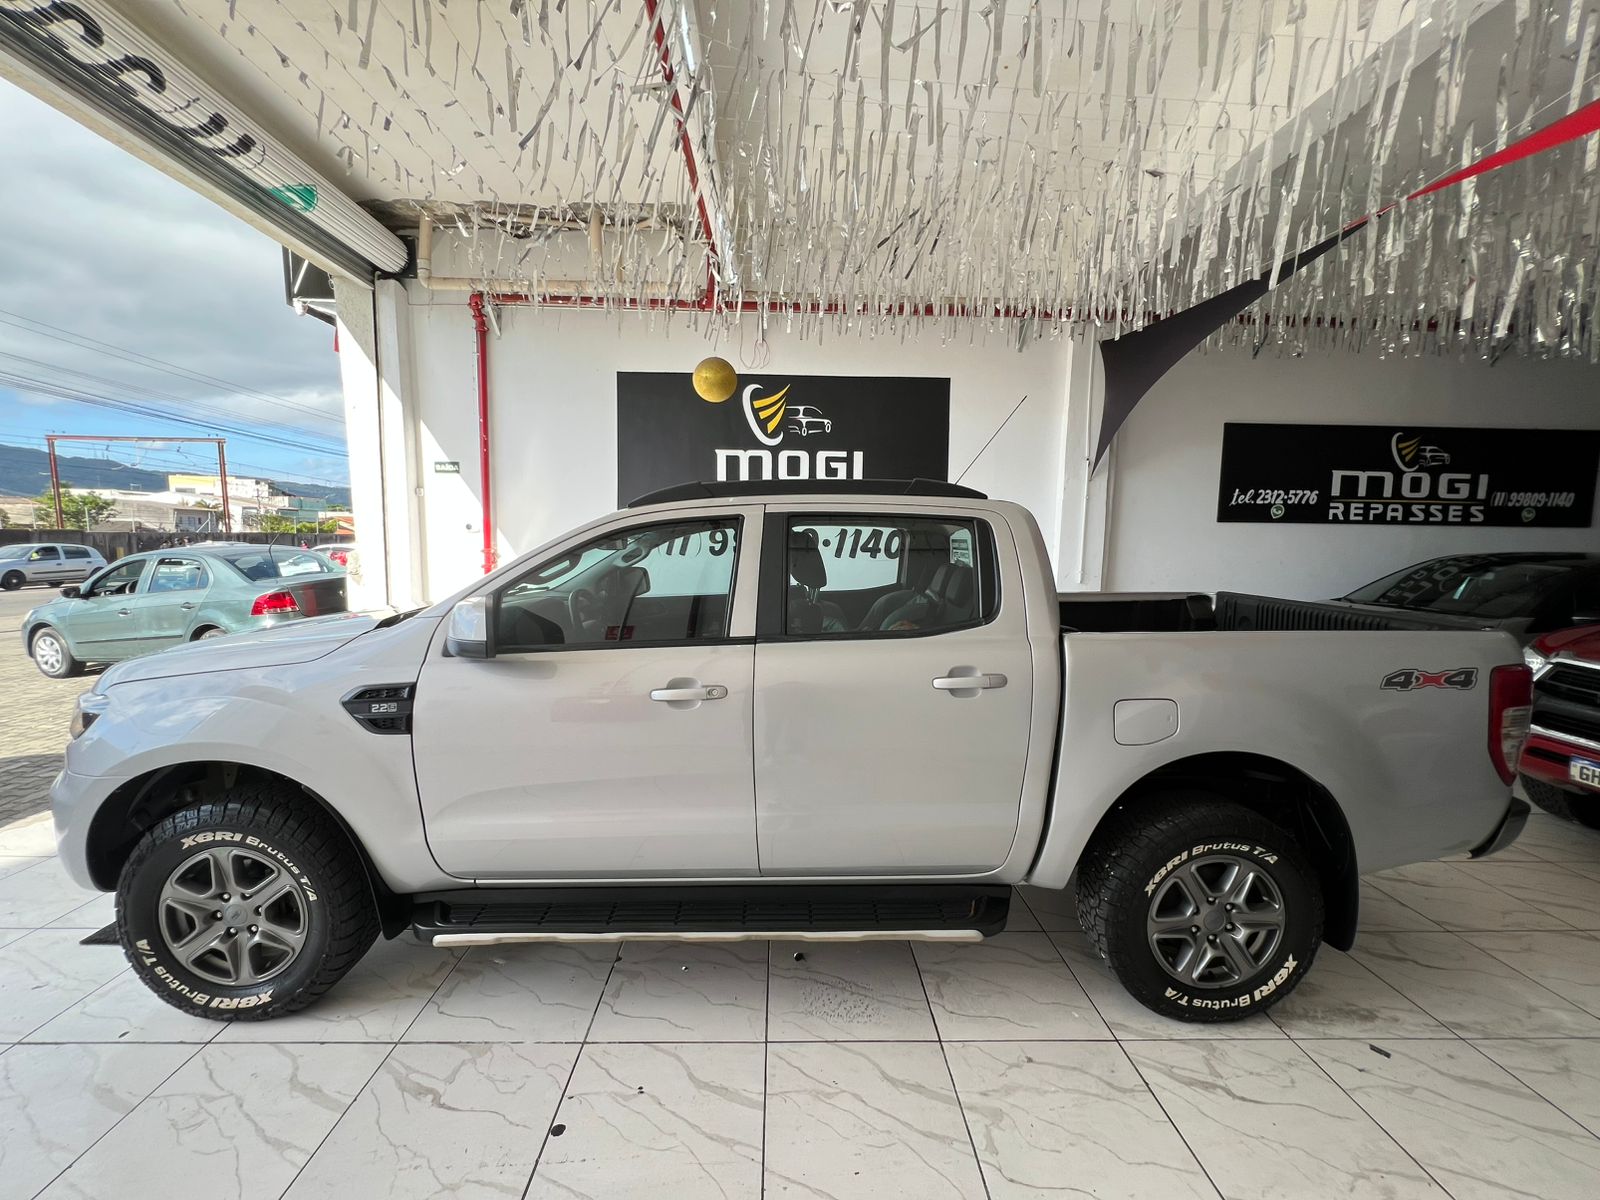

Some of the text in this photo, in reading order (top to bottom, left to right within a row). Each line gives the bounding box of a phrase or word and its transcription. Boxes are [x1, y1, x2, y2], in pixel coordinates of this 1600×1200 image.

[715, 449, 864, 481] MOGI
[1229, 488, 1254, 506] tel.
[1331, 470, 1489, 499] MOGI
[1328, 502, 1485, 522] REPASSES
[1192, 842, 1250, 856] Brutus
[1253, 846, 1278, 864] T/A
[245, 835, 300, 874] Brutus
[300, 875, 317, 901] T/A
[135, 938, 158, 967] T/A
[154, 966, 210, 1006] Brutus
[1164, 987, 1188, 1006] T/A
[1192, 994, 1250, 1010] Brutus
